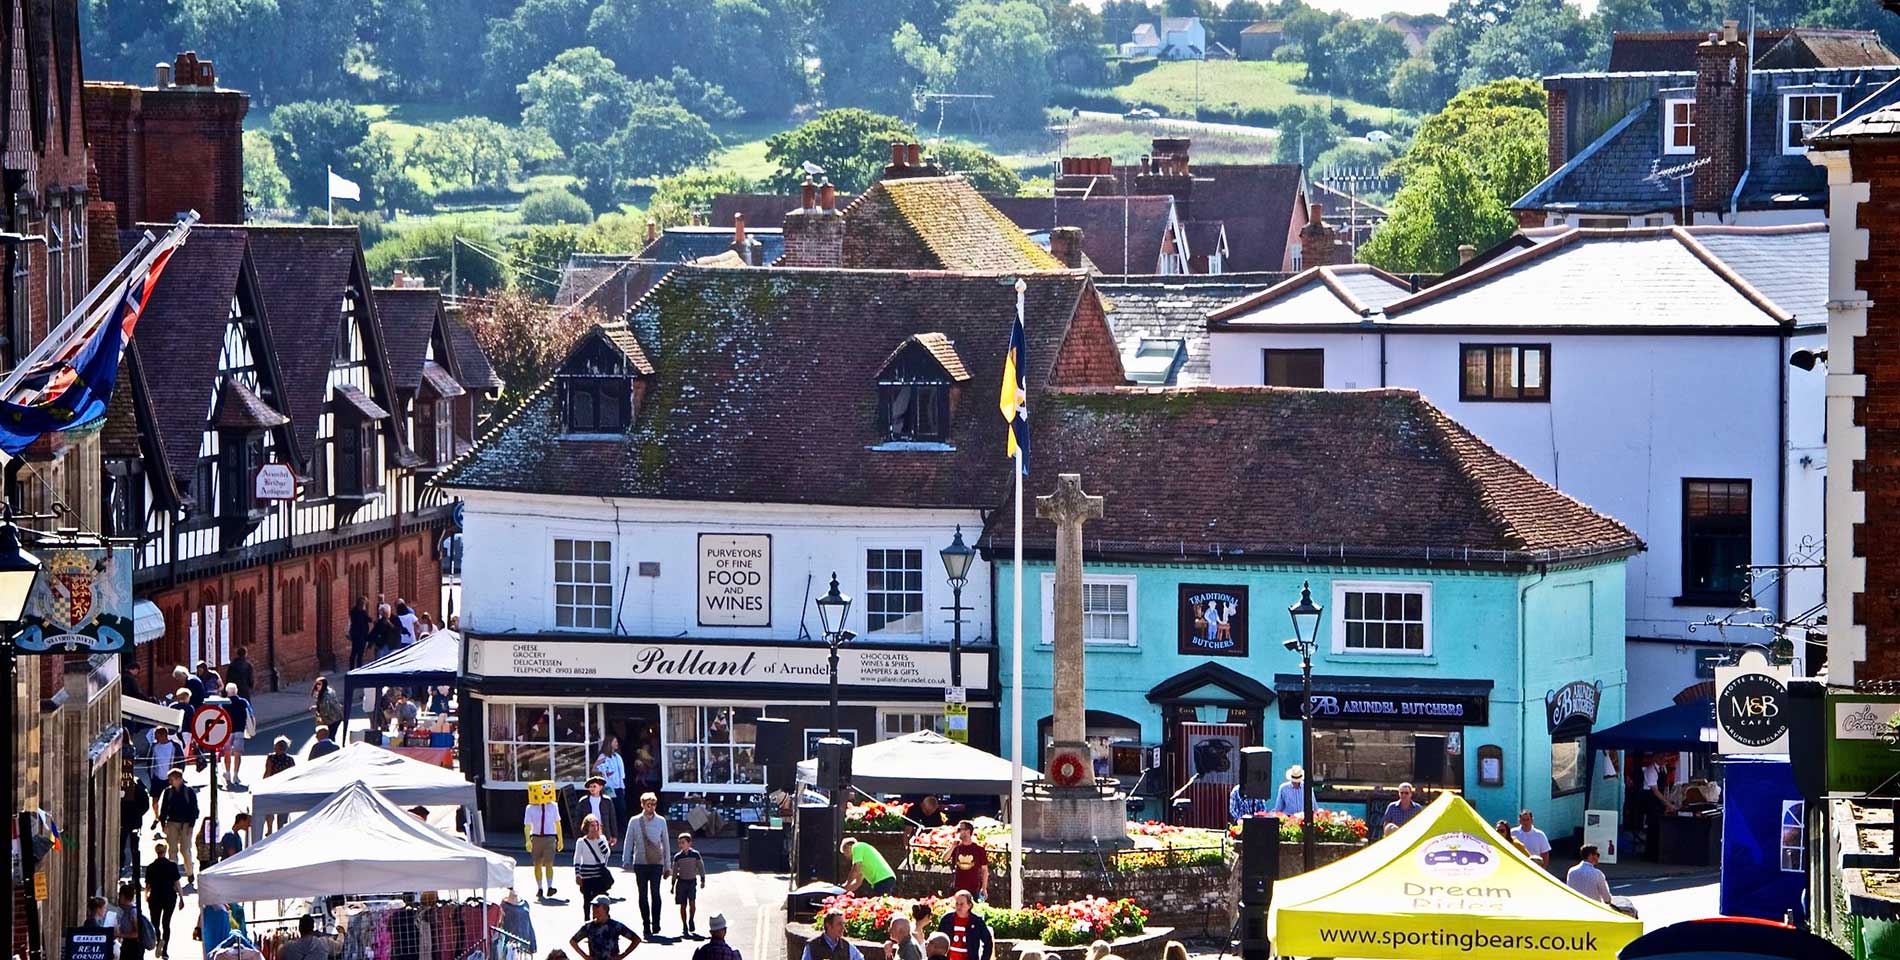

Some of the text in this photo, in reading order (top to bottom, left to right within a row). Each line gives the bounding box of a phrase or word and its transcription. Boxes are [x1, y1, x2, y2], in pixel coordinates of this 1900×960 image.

[707, 549, 762, 558] PURVEYORS
[716, 560, 752, 568] OF FINE
[708, 570, 761, 585] FOOD
[706, 596, 763, 611] WINES
[1188, 592, 1239, 605] TRADITIONAL
[512, 644, 538, 652] CHEESE
[1192, 636, 1235, 649] BUTCHERS
[513, 659, 562, 667] DELICATESSEN
[632, 646, 831, 676] Pallant of Arundel
[860, 653, 909, 661] CHOCOLATES
[860, 676, 946, 684] www.pallantofarundel.co.uk
[1723, 676, 1746, 697] MOTTE
[1758, 675, 1785, 694] BAILEY
[1343, 701, 1398, 714] ARUNDEL
[1401, 702, 1464, 717] BUTCHERS
[1731, 695, 1779, 718] M&B
[1740, 718, 1771, 726] CAFÉ
[1725, 725, 1786, 745] ARUNDEL ENGLAND
[1403, 882, 1512, 898] Dream
[1320, 928, 1597, 951] www.sportingbears.co.uk
[78, 945, 101, 953] REAL
